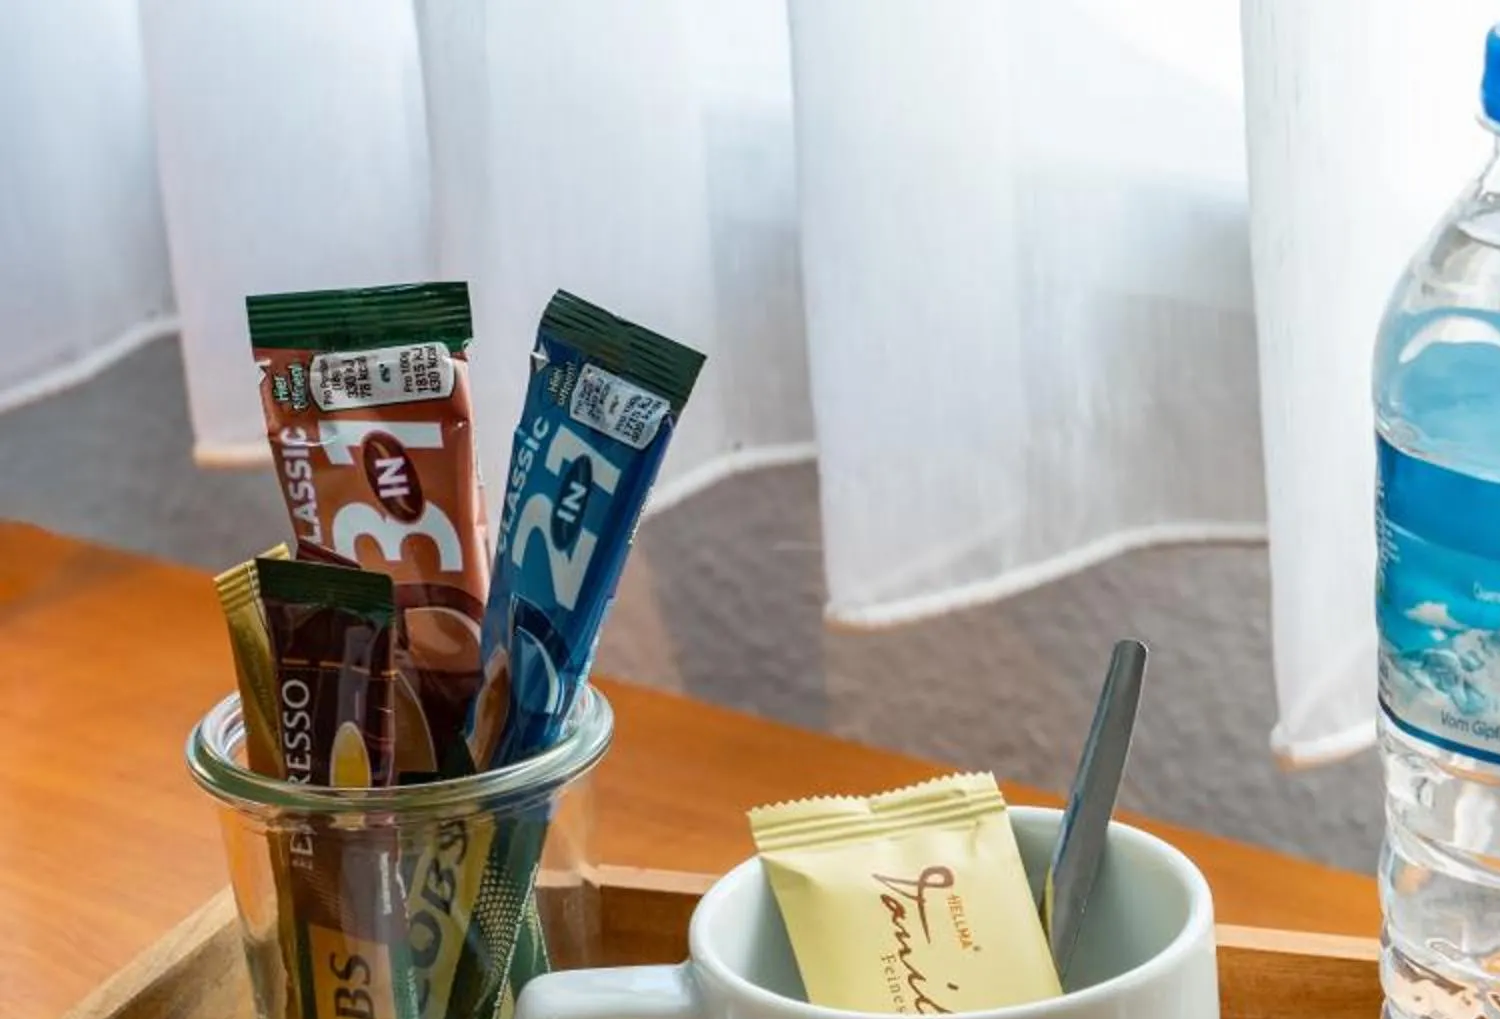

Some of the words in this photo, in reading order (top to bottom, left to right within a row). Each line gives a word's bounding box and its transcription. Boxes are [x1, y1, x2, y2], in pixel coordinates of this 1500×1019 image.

[280, 425, 323, 545] LASSIC
[375, 456, 411, 498] IN
[556, 481, 588, 524] IN
[1440, 709, 1470, 733] Vom
[281, 679, 314, 857] ERESSO
[946, 893, 974, 950] HELLMA
